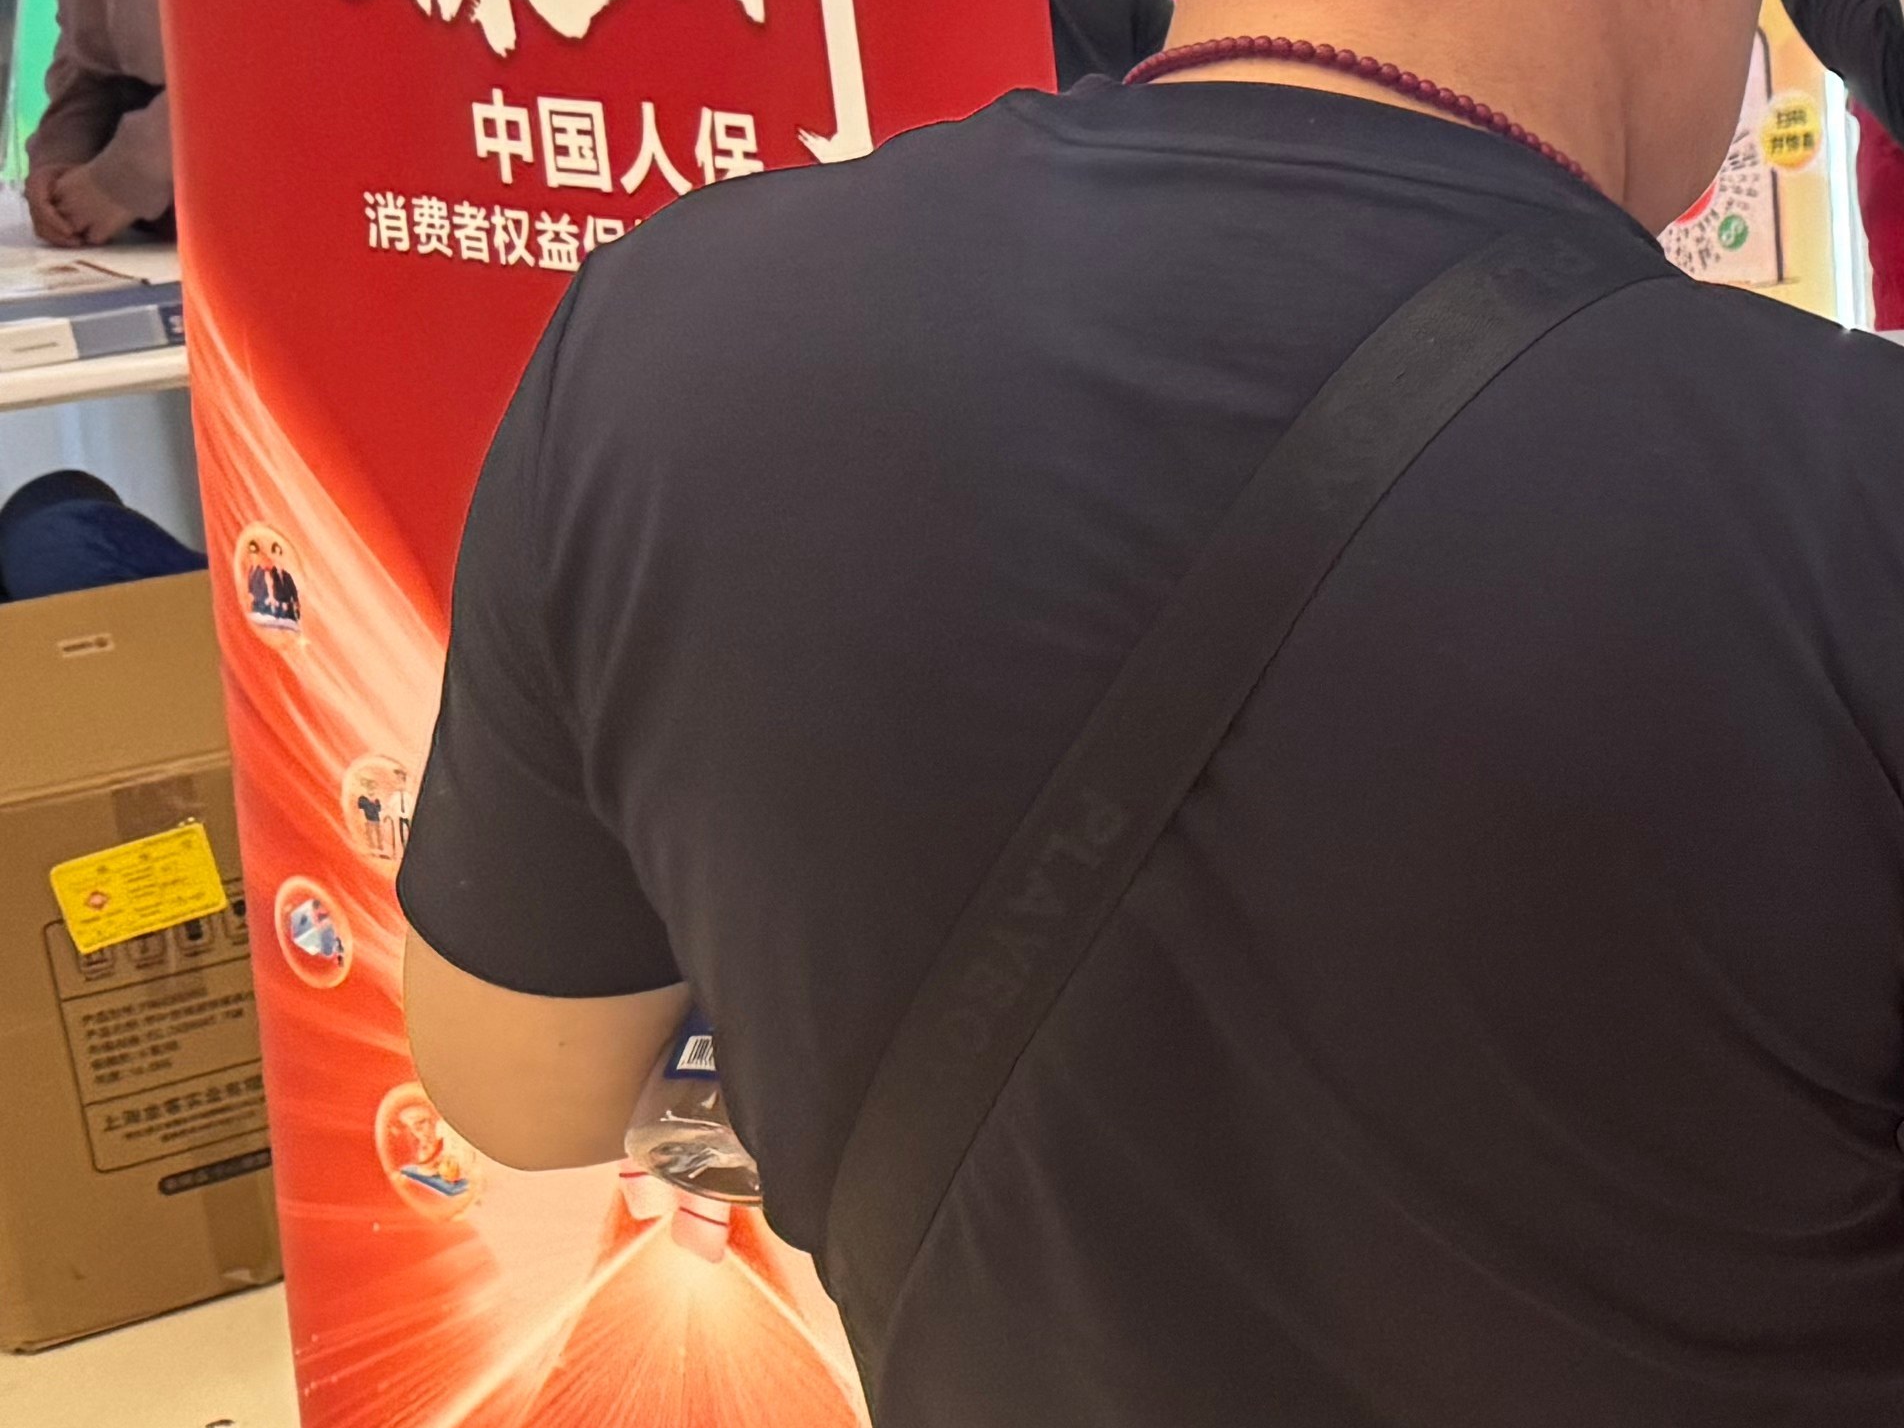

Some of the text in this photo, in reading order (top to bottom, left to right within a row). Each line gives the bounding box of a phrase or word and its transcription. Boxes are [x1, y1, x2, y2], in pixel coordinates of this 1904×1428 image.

[470, 88, 764, 194] 中国人保
[363, 190, 645, 273] 消费者权益
